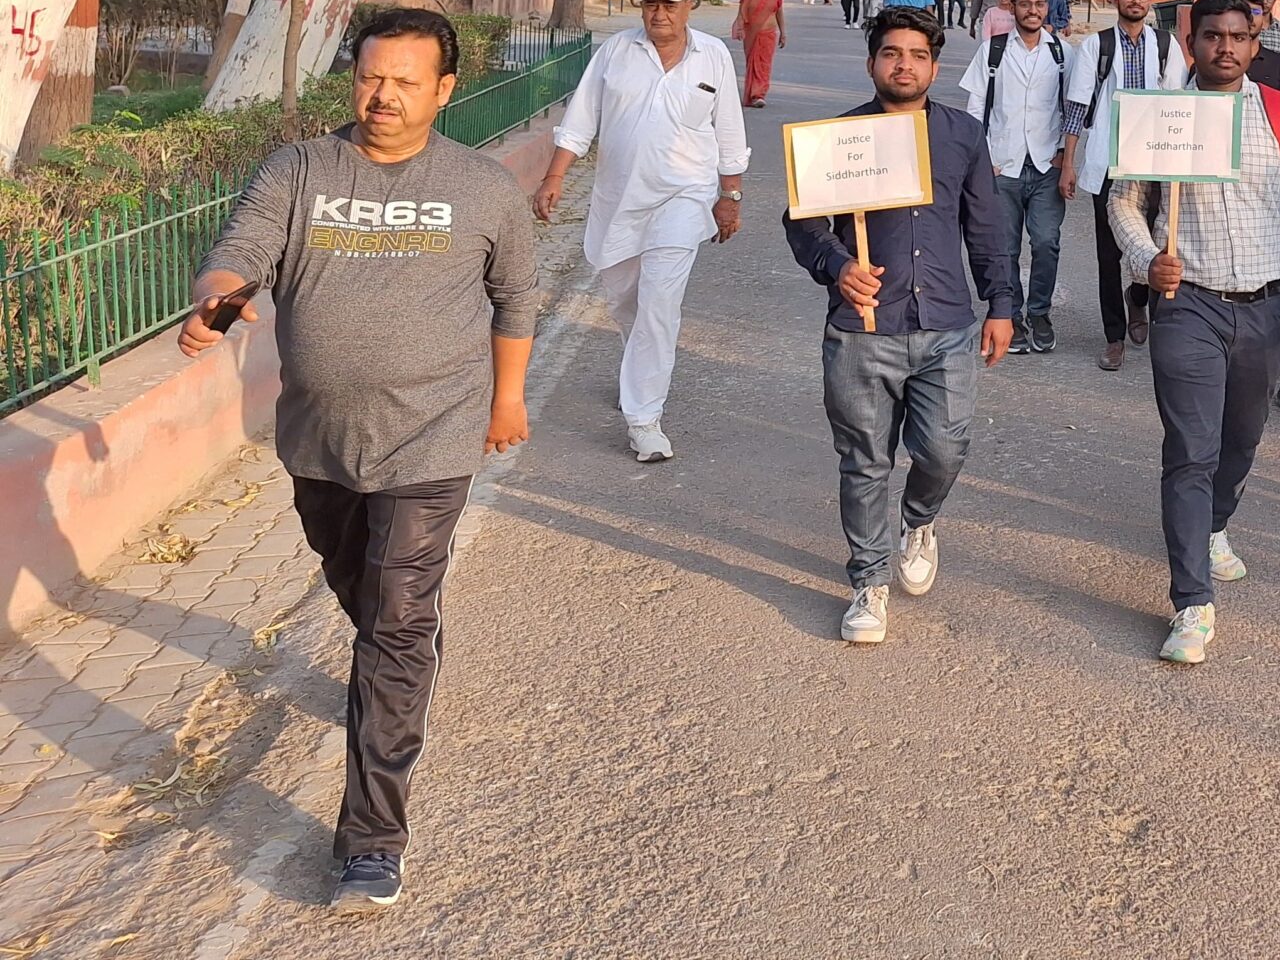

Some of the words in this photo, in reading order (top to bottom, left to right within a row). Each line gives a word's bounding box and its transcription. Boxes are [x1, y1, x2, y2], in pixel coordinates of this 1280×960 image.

[12, 5, 47, 57] 45
[1160, 109, 1192, 119] Justice
[1167, 125, 1184, 135] For
[836, 134, 871, 146] Justice
[1146, 141, 1204, 151] Siddharthan
[847, 152, 864, 161] For
[825, 166, 889, 181] Siddharthan
[312, 194, 453, 226] KR63
[311, 220, 371, 232] CONSTRUCTED
[426, 225, 452, 233] STYLE
[307, 226, 453, 253] ENGNRD
